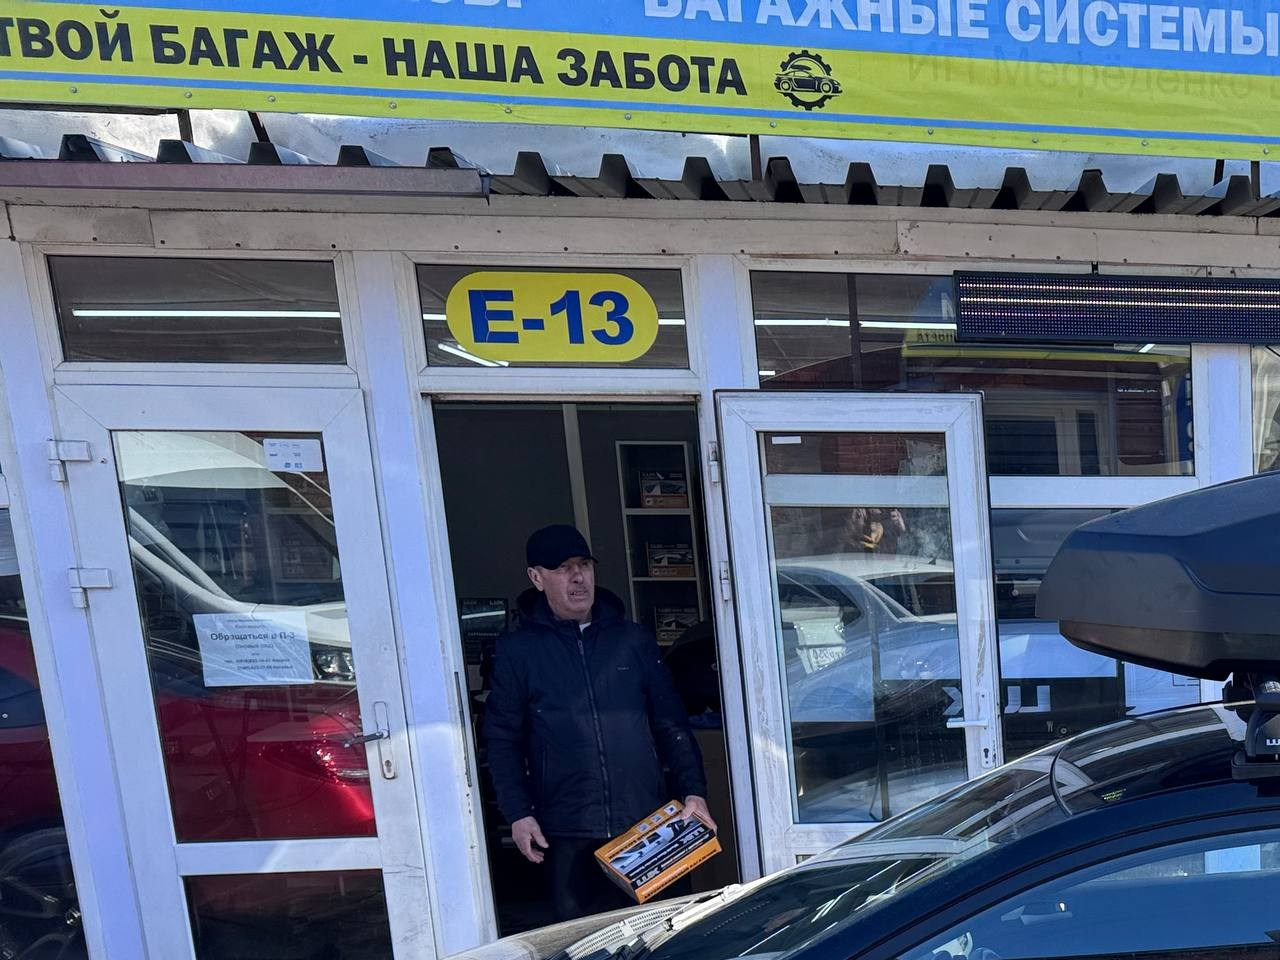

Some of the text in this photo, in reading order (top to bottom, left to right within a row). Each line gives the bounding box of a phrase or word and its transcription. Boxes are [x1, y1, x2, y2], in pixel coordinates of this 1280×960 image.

[0, 9, 134, 62] ТВОЙ
[149, 24, 343, 73] БАГАЖ
[382, 37, 540, 85] НАША
[557, 51, 748, 97] ЗАБОТА
[1005, 0, 1280, 57] СИСТЕМЫ
